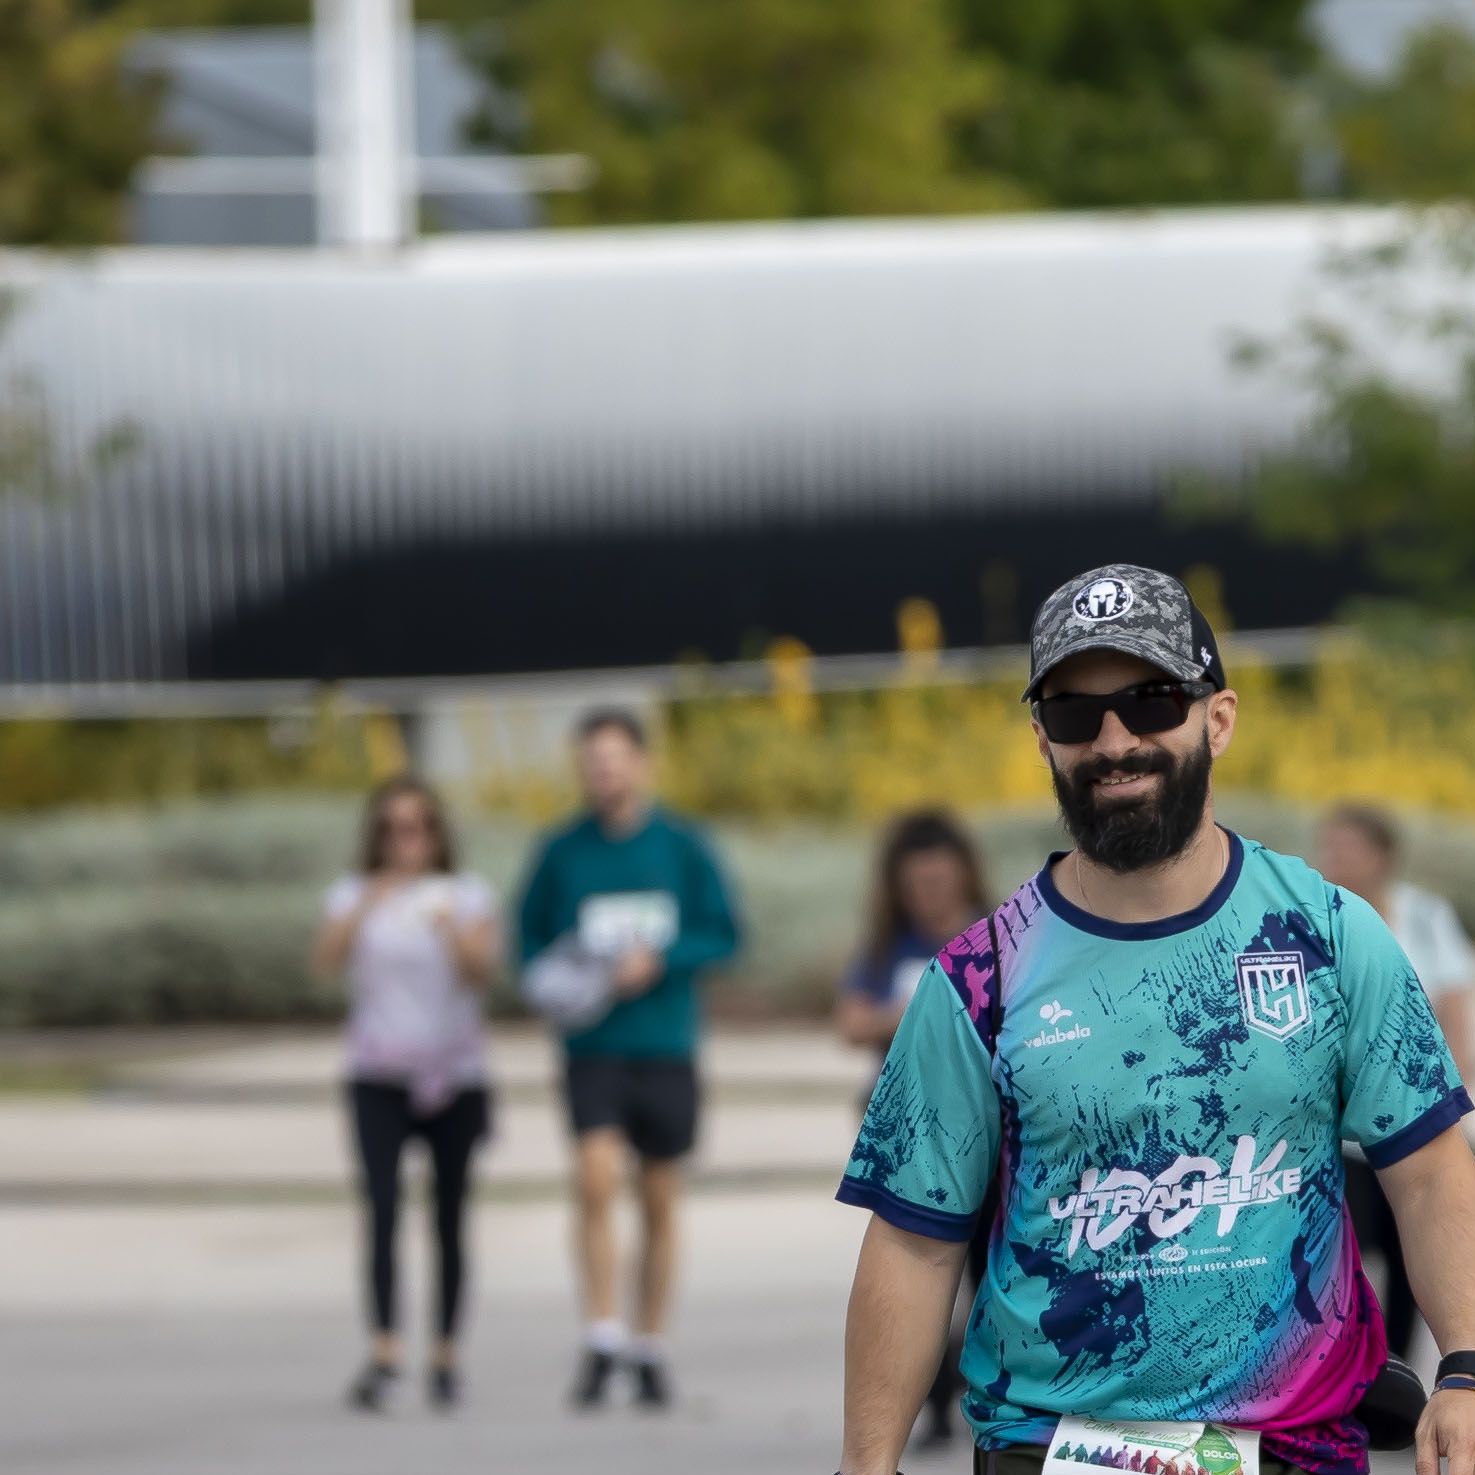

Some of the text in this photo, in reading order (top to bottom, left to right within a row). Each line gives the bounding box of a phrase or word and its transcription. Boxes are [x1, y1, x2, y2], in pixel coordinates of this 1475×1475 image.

[1187, 1264, 1201, 1273] EN
[1204, 1261, 1228, 1272] ESTA
[1230, 1255, 1268, 1269] LOCURA
[1202, 1449, 1239, 1461] DOLOR
